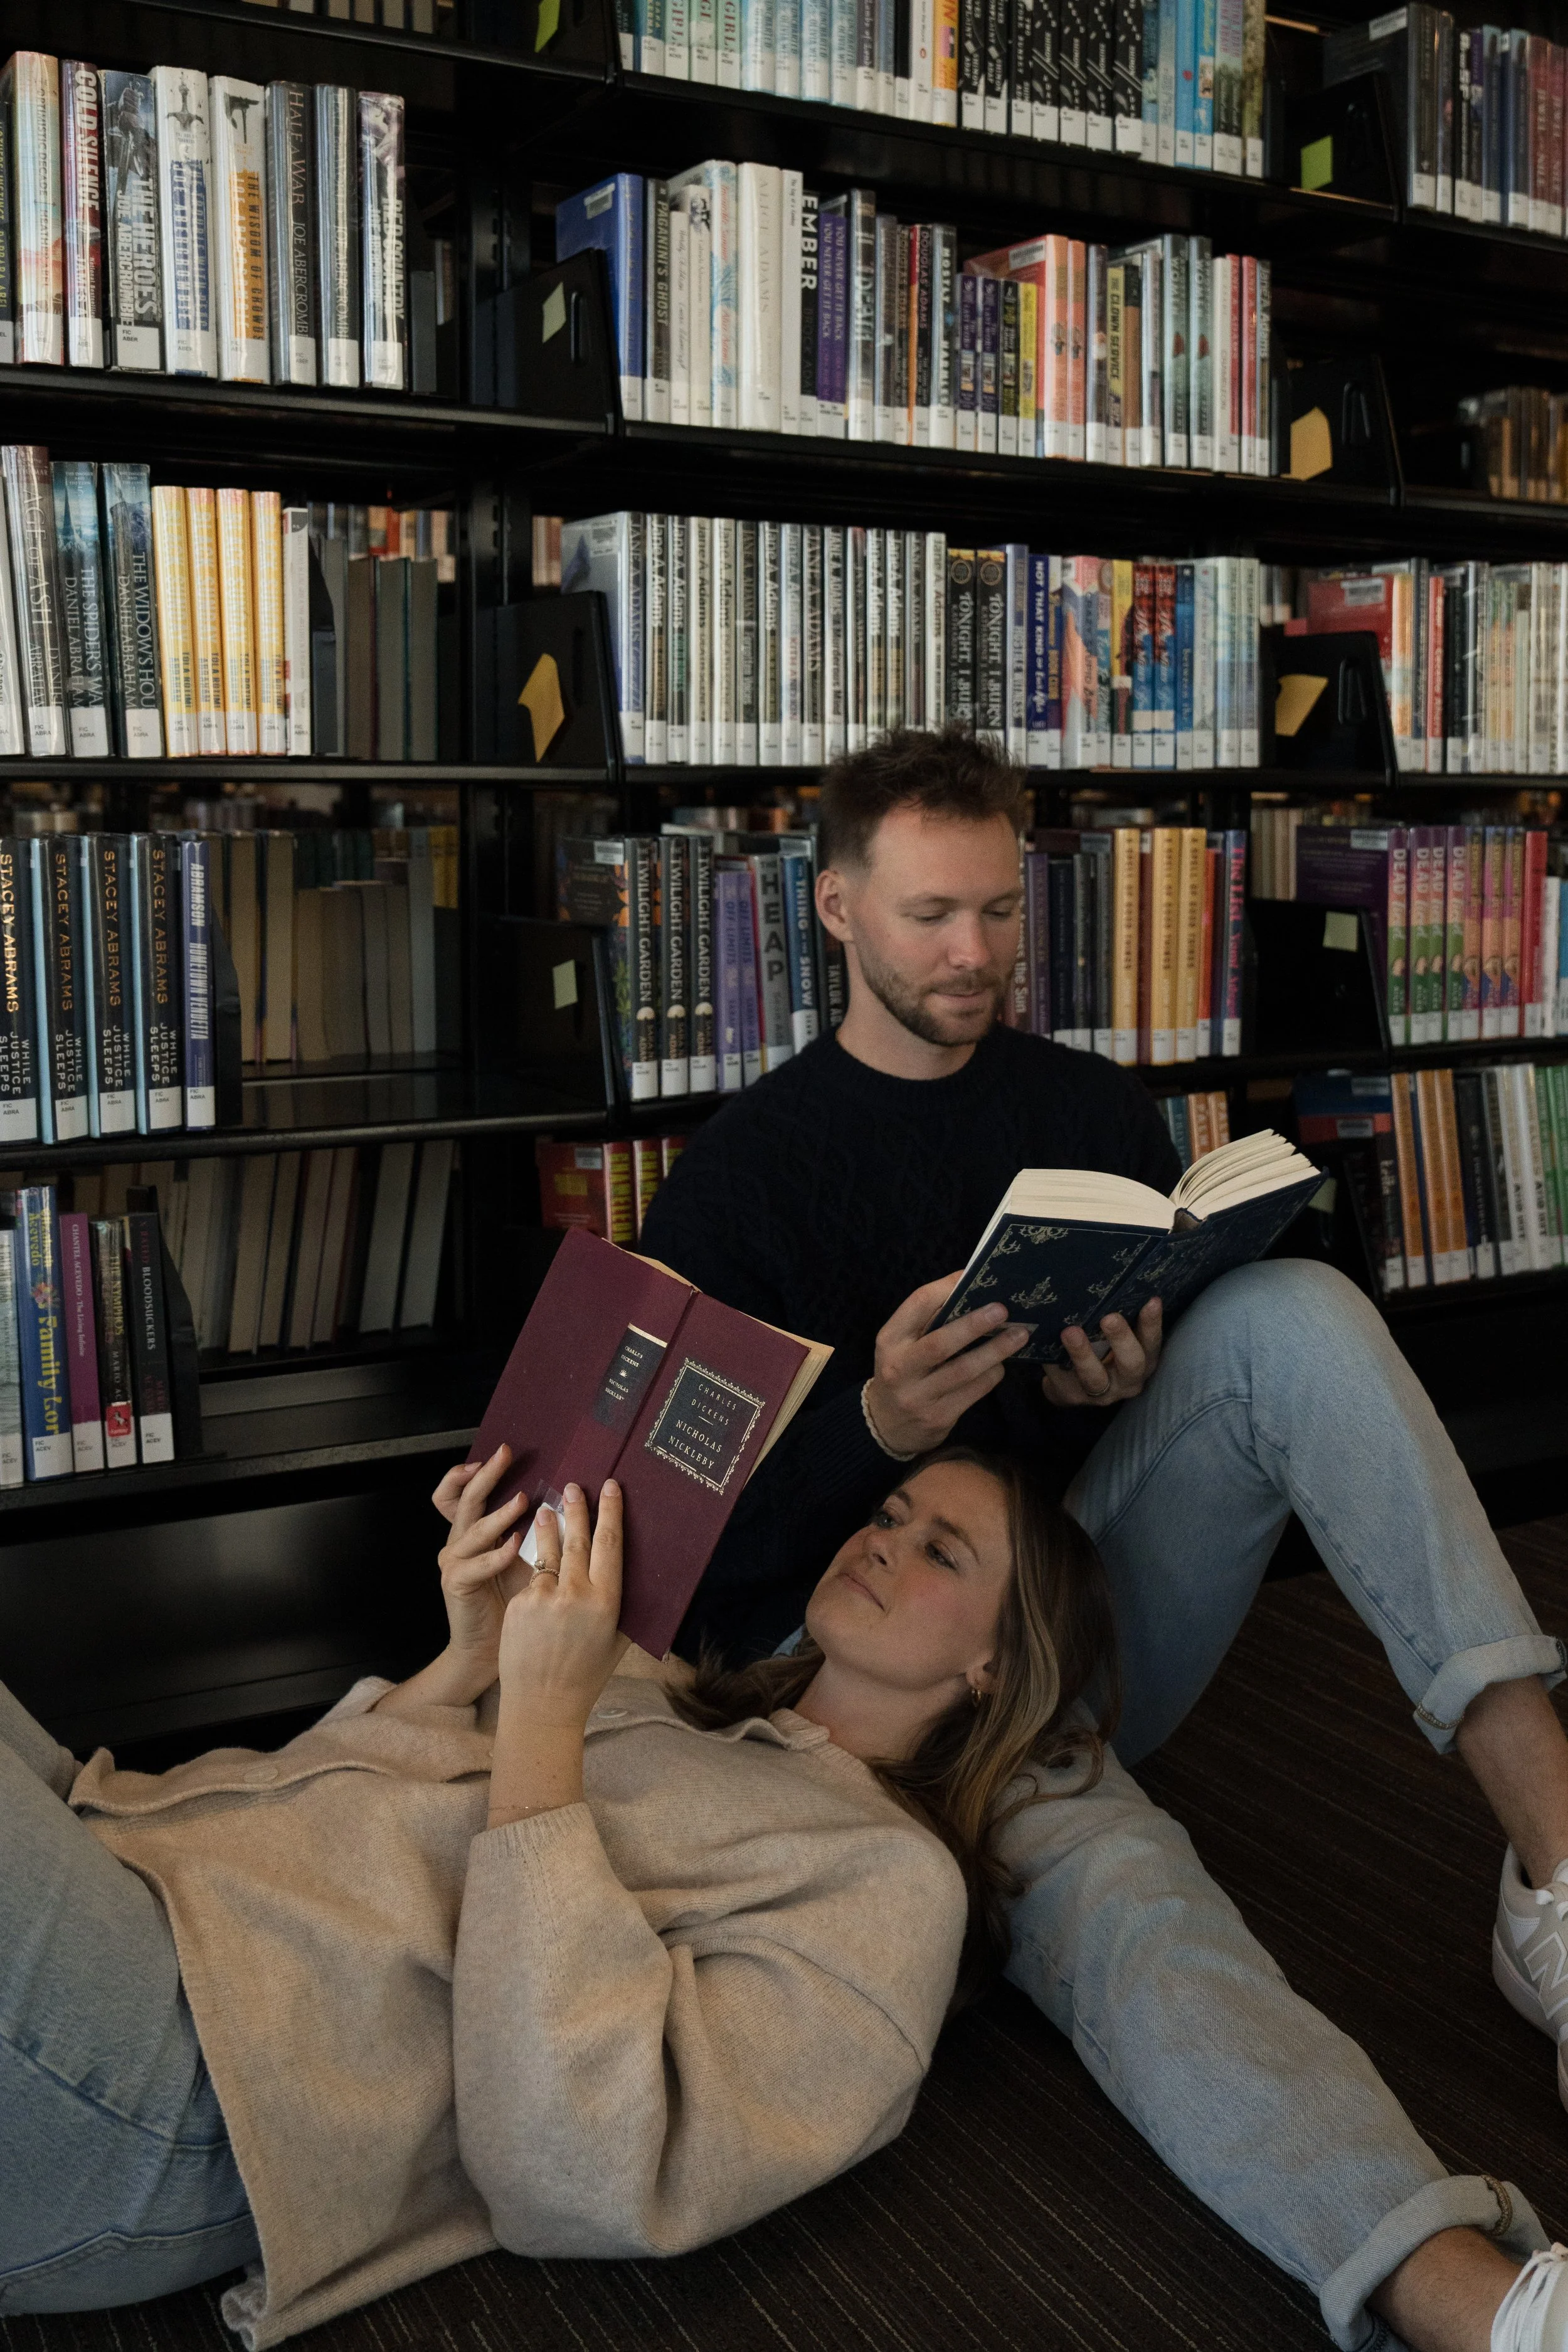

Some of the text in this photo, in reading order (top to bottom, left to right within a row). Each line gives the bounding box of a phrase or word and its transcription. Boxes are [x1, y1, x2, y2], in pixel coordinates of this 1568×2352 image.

[36, 88, 48, 196] OPTIMISTIC DECADE
[74, 70, 99, 211] COLD SILENCE
[289, 92, 306, 246] HALF WAR JOE
[173, 163, 186, 196] JOE
[117, 189, 135, 326] JOE ABERCROMBIE
[132, 177, 157, 314] THE HEROES
[248, 175, 265, 340] THE WISDOM OF CROWDS
[381, 198, 405, 320] RED COUNTRY
[657, 200, 669, 327] PAGANINI'S GHOST
[801, 194, 818, 290] EMBER
[822, 222, 832, 339] YOU NEVER GET BACK
[834, 225, 844, 341] YOU NEVER GET BACK
[919, 230, 929, 329] DOUGLAS ADAMS
[941, 247, 951, 303] MOSTLY
[856, 276, 873, 341] DEATH
[1110, 293, 1120, 332] CLOWN
[1260, 313, 1271, 359] Adams
[23, 489, 45, 540] AGE
[28, 576, 52, 625] ASH
[652, 522, 665, 628] Jane Adams
[673, 523, 686, 628] Jane Adams
[766, 526, 780, 631] Jane Adams
[81, 566, 102, 671] THE SPIDER'S
[132, 551, 156, 707] THE WIDOW'S HOU
[808, 607, 822, 672] ADAMS
[955, 591, 975, 664] TONIGHT
[987, 593, 1004, 665] TONIGHT
[1035, 561, 1045, 655] NOT THAT KIND
[65, 576, 85, 709] DANIEL ABRAHAM
[117, 575, 137, 709] DANIEL ABRAHAM
[987, 678, 1002, 728] BURN
[190, 862, 205, 926] ABRAMSON
[1393, 849, 1406, 895] DEAD
[1417, 848, 1429, 893] DEAD
[1433, 847, 1444, 891] DEAD
[1453, 846, 1465, 891] DEAD
[0, 854, 19, 1013] STACEY ABRAMS
[55, 853, 73, 1011] STACEY ABRAMS
[103, 850, 121, 1007] STACEY ABRAMS
[152, 849, 168, 1004] STACEY ABRAMS
[637, 860, 653, 1002] TWILIGHT GARDEN
[670, 859, 684, 1000] TWILIGHT GARDEN
[697, 857, 711, 998] TWILIGHT GARDEN
[760, 874, 785, 982] HEAP
[189, 941, 208, 995] HOMETOWN
[799, 956, 813, 1006] SNOW
[827, 965, 842, 1004] TAYLOR
[1015, 961, 1029, 1014] the Sun
[189, 996, 209, 1040] VENDETTA
[0, 1036, 10, 1092] SLEEPS
[9, 1030, 22, 1094] JUSTICE
[22, 1039, 31, 1084] WHILE
[56, 1034, 66, 1091] SLEEPS
[65, 1029, 75, 1092] JUSTICE
[75, 1036, 83, 1082] WHILE
[102, 1028, 113, 1085] SLEEPS
[112, 1024, 123, 1087] JUSTICE
[123, 1032, 131, 1077] WHILE
[150, 1025, 160, 1082] SLEEPS
[160, 1022, 170, 1084] JUSTICE
[169, 1029, 177, 1074] WHILE
[72, 1224, 82, 1259] CHANTEL
[74, 1261, 83, 1296] ACEVEDO
[111, 1279, 125, 1336] NYMPHOS
[141, 1266, 157, 1350] BLOODSUCKERS
[38, 1315, 62, 1435] Family Lor
[112, 1350, 121, 1384] MARIO
[620, 1354, 639, 1367] DICKENS
[625, 1345, 644, 1359] CHARLES
[605, 1387, 625, 1401] NICKLEBY
[608, 1378, 628, 1393] NICHOLAS
[691, 1399, 729, 1426] DICKENS
[698, 1384, 736, 1411] CHARLES
[668, 1435, 714, 1469] NICKLEBY
[675, 1419, 722, 1453] NICHOLAS
